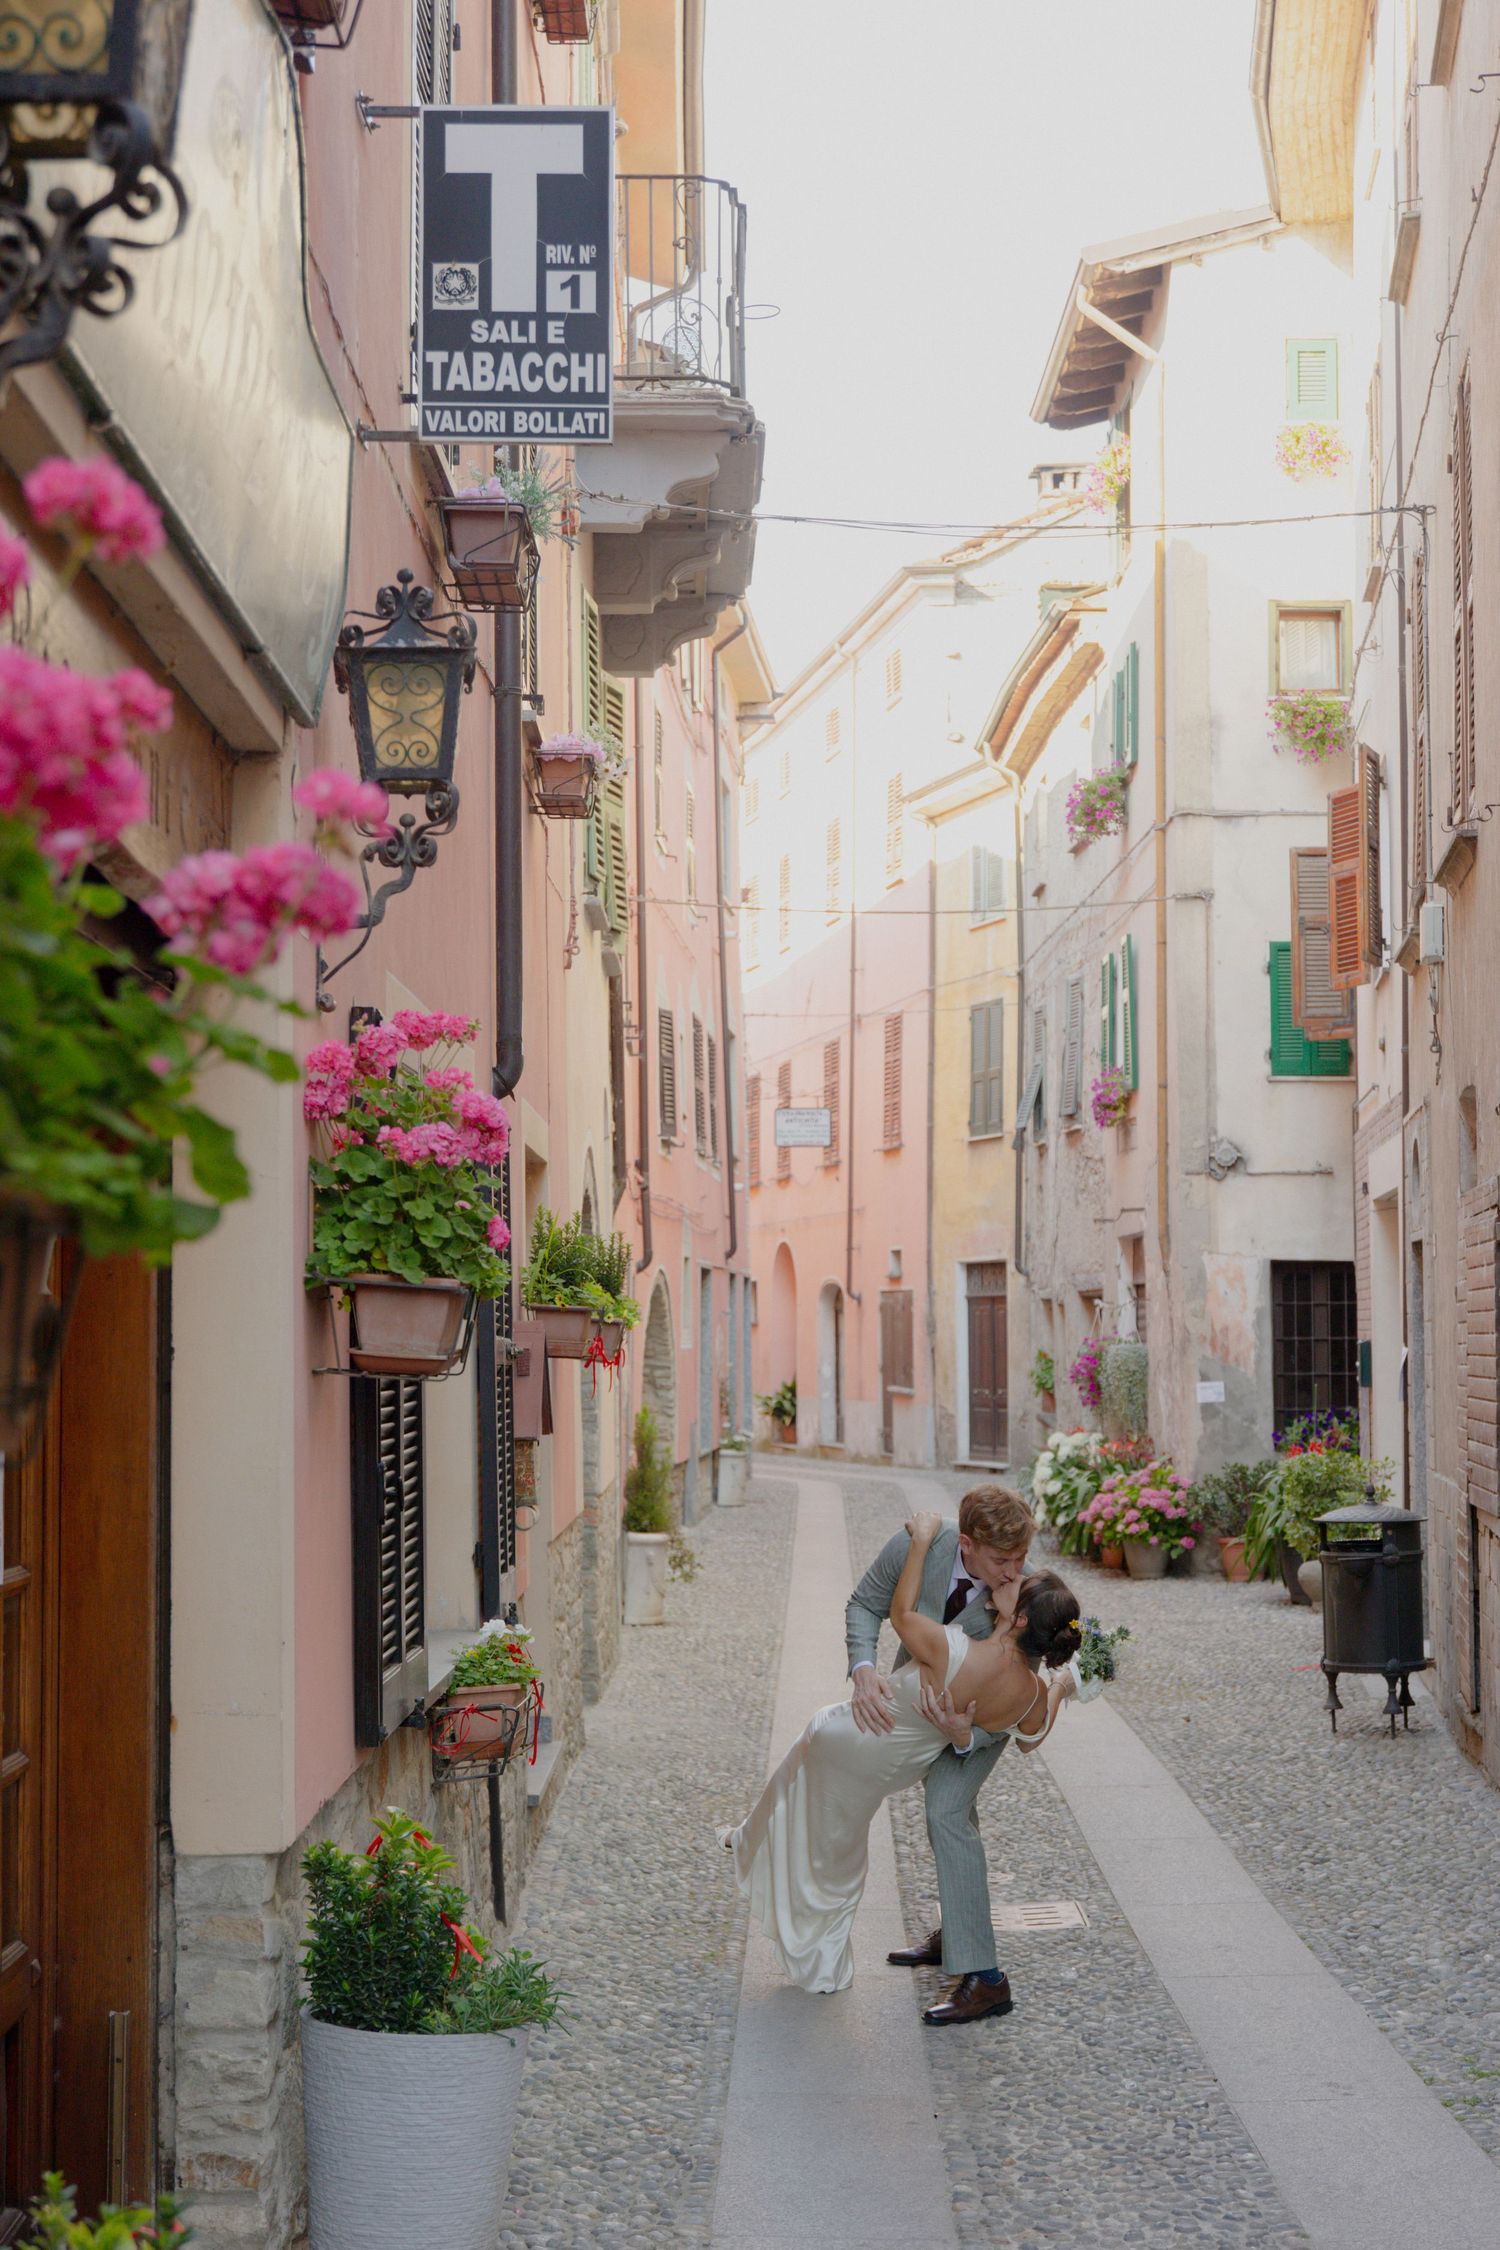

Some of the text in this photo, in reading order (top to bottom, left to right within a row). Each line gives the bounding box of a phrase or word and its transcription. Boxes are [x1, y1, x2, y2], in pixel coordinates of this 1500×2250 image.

[445, 123, 584, 313] T
[546, 244, 575, 265] RIV.
[559, 274, 581, 310] 1
[470, 319, 566, 344] SALI E
[424, 350, 606, 393] TABACCHI
[425, 409, 606, 435] VALORI BOLLATI
